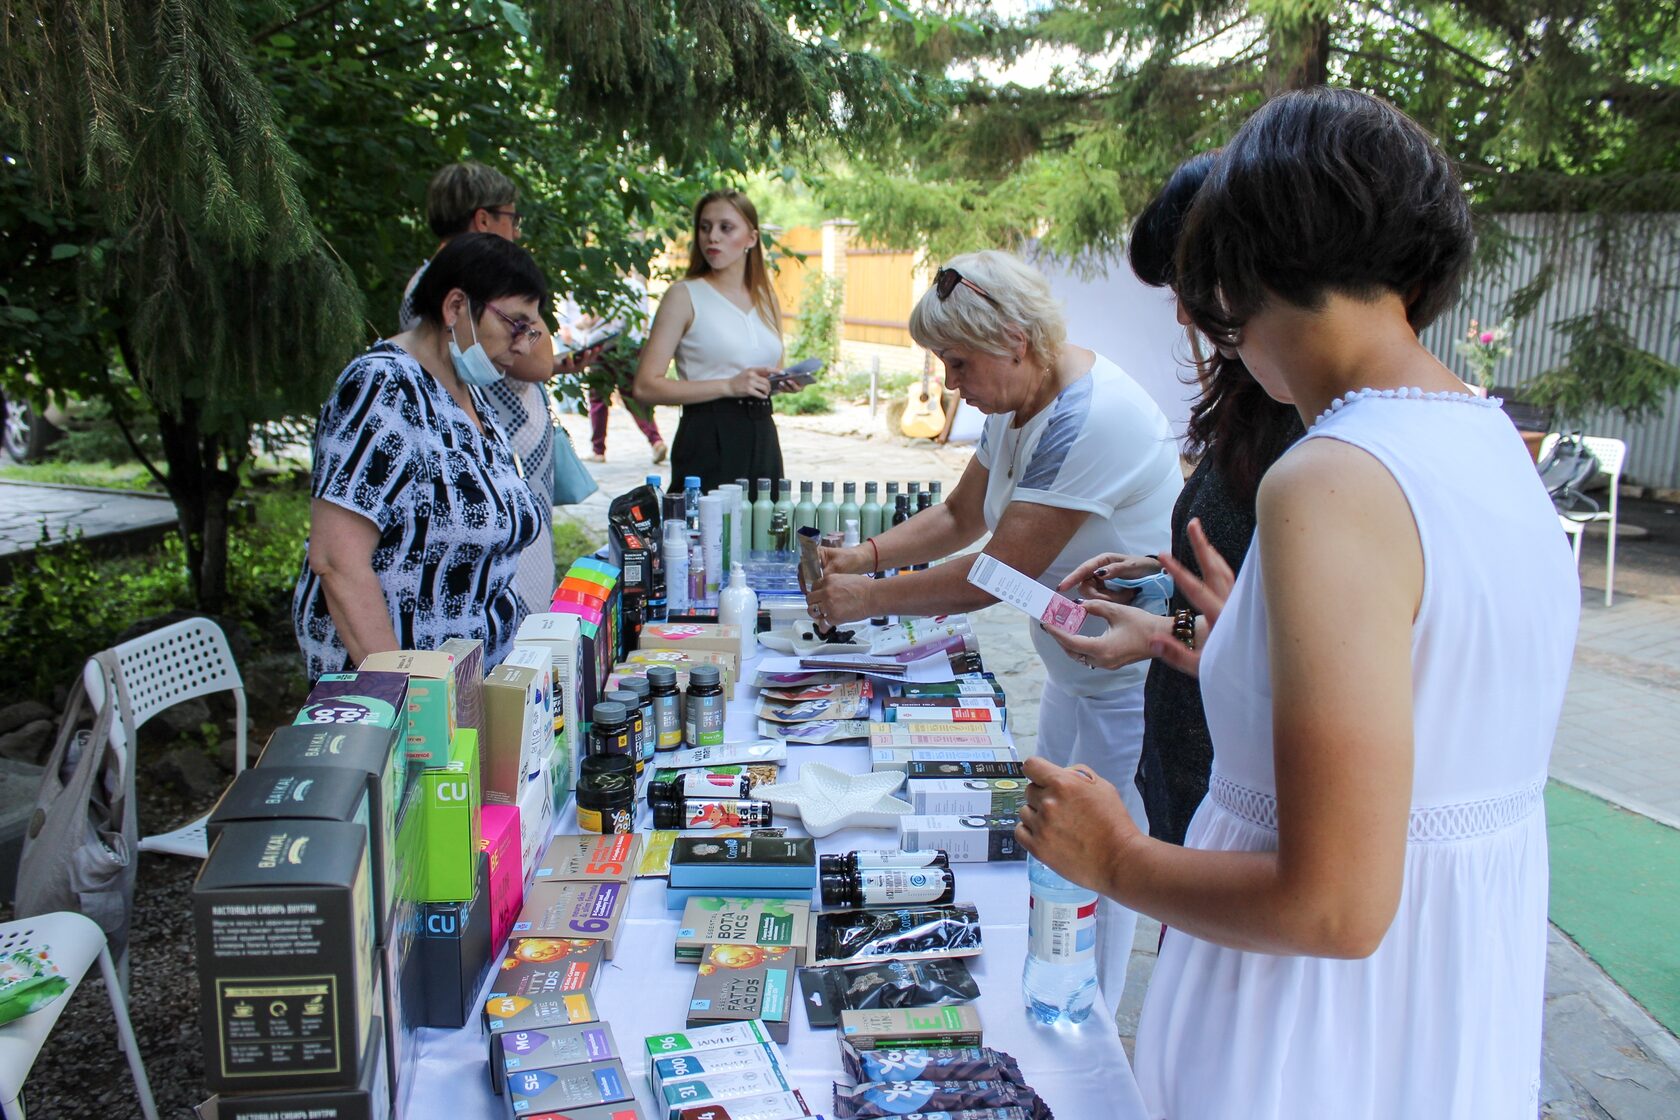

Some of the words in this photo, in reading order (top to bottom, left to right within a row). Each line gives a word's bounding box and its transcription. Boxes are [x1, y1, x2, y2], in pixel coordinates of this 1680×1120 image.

[305, 732, 328, 757] BAIKAL
[265, 776, 294, 804] BAIKAL
[437, 782, 467, 801] CU
[258, 833, 288, 868] BAIKAL
[585, 862, 624, 875] 5
[428, 914, 455, 933] CU
[569, 919, 609, 933] 6
[718, 911, 735, 940] BOTA
[733, 914, 749, 940] NICS
[526, 970, 546, 994] TTY
[542, 970, 560, 994] IDS
[728, 978, 741, 1011] FATTY
[744, 978, 760, 1012] ACIDS
[501, 999, 516, 1013] ZN
[913, 1015, 943, 1029] E
[517, 1033, 530, 1050] MG
[662, 1036, 678, 1049] 96
[671, 1058, 690, 1075] 900
[525, 1073, 539, 1090] SE
[678, 1085, 698, 1099] 31
